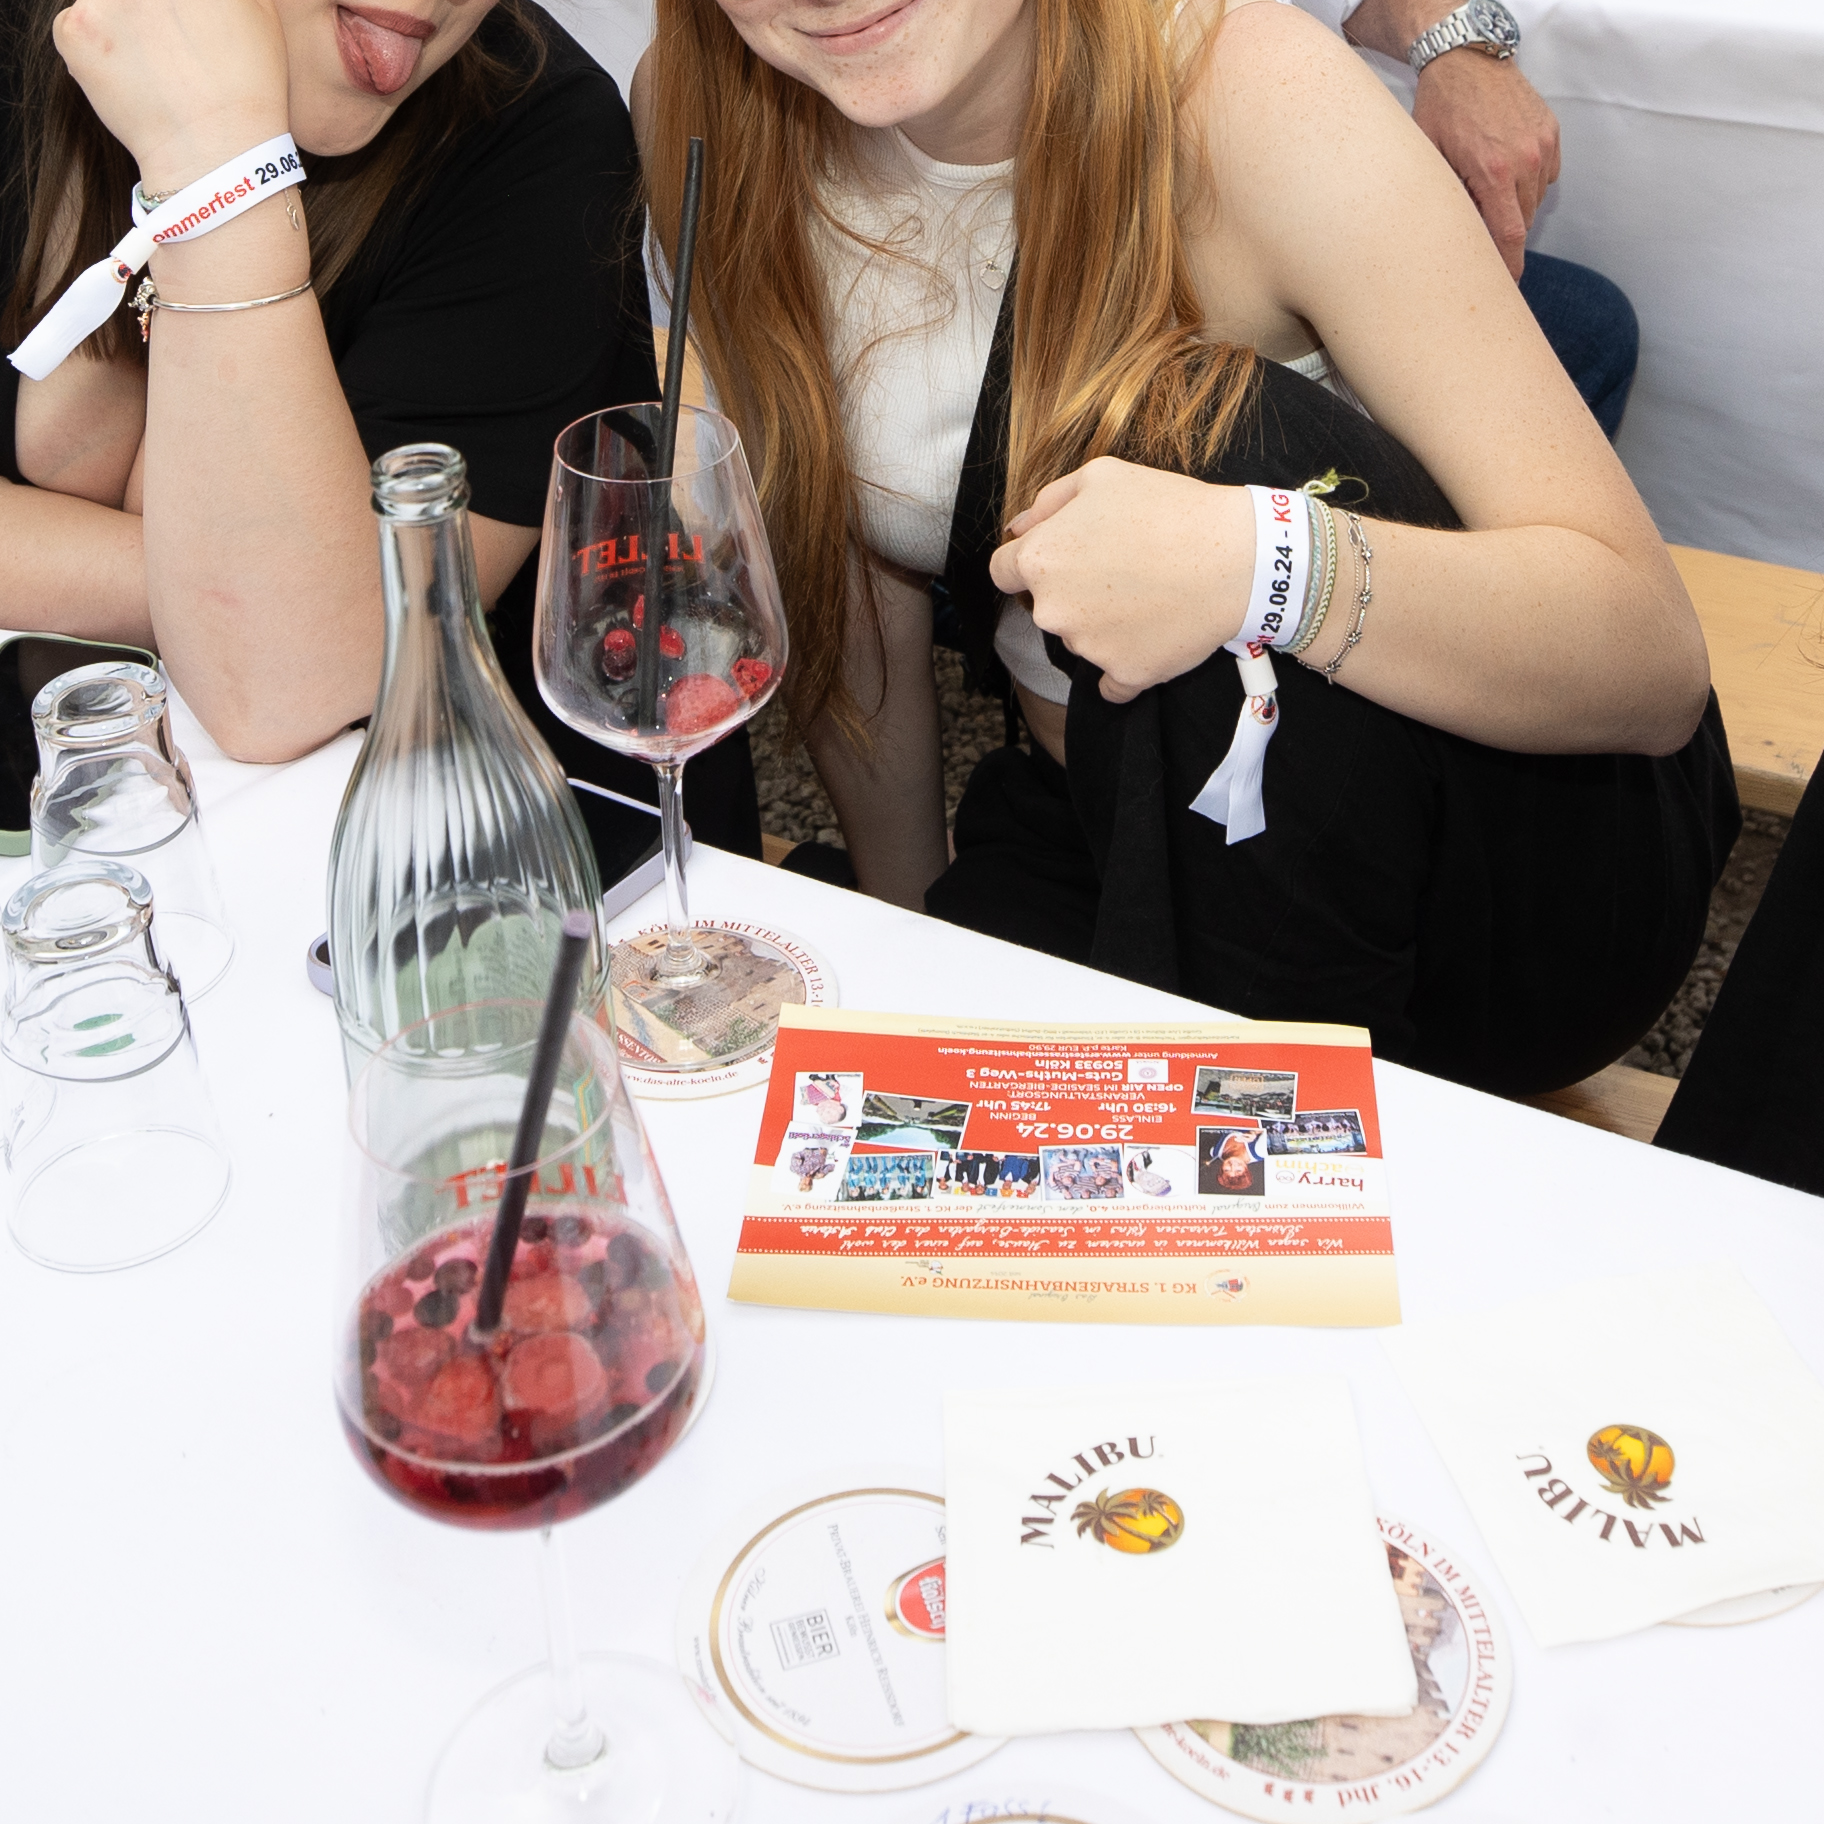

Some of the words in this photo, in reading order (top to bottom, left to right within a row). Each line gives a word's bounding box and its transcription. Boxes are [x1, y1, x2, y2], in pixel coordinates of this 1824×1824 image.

[152, 177, 256, 244] ommerfest
[1271, 493, 1293, 524] KG
[1261, 545, 1294, 634] 29.06.24
[721, 920, 821, 976] MITTELALTER
[1162, 1051, 1218, 1060] Anmeldung
[1035, 1059, 1071, 1070] Köln
[1074, 1060, 1123, 1070] 50933
[966, 1069, 975, 1078] 3
[980, 1068, 1123, 1082] Guts-Muths-Weg
[970, 1081, 1101, 1091] SEASIDE-BIERGARTEN
[1104, 1083, 1118, 1091] IM
[1122, 1083, 1145, 1091] AIR
[1149, 1083, 1183, 1091] OPEN
[1007, 1091, 1145, 1100] VERANSTALTUNGSORT:
[976, 1099, 1007, 1110] Uhr
[1010, 1101, 1051, 1111] 17:45
[1098, 1102, 1128, 1112] Uhr
[1132, 1103, 1176, 1112] 16:30
[990, 1112, 1036, 1120] BEGINN
[1016, 1122, 1133, 1139] 29.06.24
[1298, 1171, 1364, 1191] harry
[955, 1205, 973, 1213] der
[1112, 1203, 1206, 1212] Kulturbiergarten
[1292, 1203, 1364, 1211] Willkommen
[865, 1225, 896, 1237] Club
[1156, 1224, 1227, 1235] Terrassen
[1236, 1224, 1303, 1238] schönsten
[840, 1240, 874, 1250] wohl
[881, 1240, 906, 1250] der
[915, 1240, 949, 1250] einer
[955, 1235, 983, 1249] auf
[1085, 1240, 1144, 1248] unserem
[1154, 1240, 1167, 1249] in
[1176, 1239, 1259, 1251] Willkommen
[1267, 1234, 1308, 1247] sagen
[1317, 1238, 1343, 1249] Wir
[900, 1276, 928, 1287] e.V.
[1154, 1282, 1165, 1293] 1.
[1172, 1282, 1197, 1294] KG
[1021, 1435, 1156, 1550] MALIBU
[1516, 1453, 1708, 1549] MALIBU
[806, 1613, 834, 1658] BIER
[1433, 1557, 1460, 1584] IM
[1454, 1583, 1496, 1742] MITTELALTER
